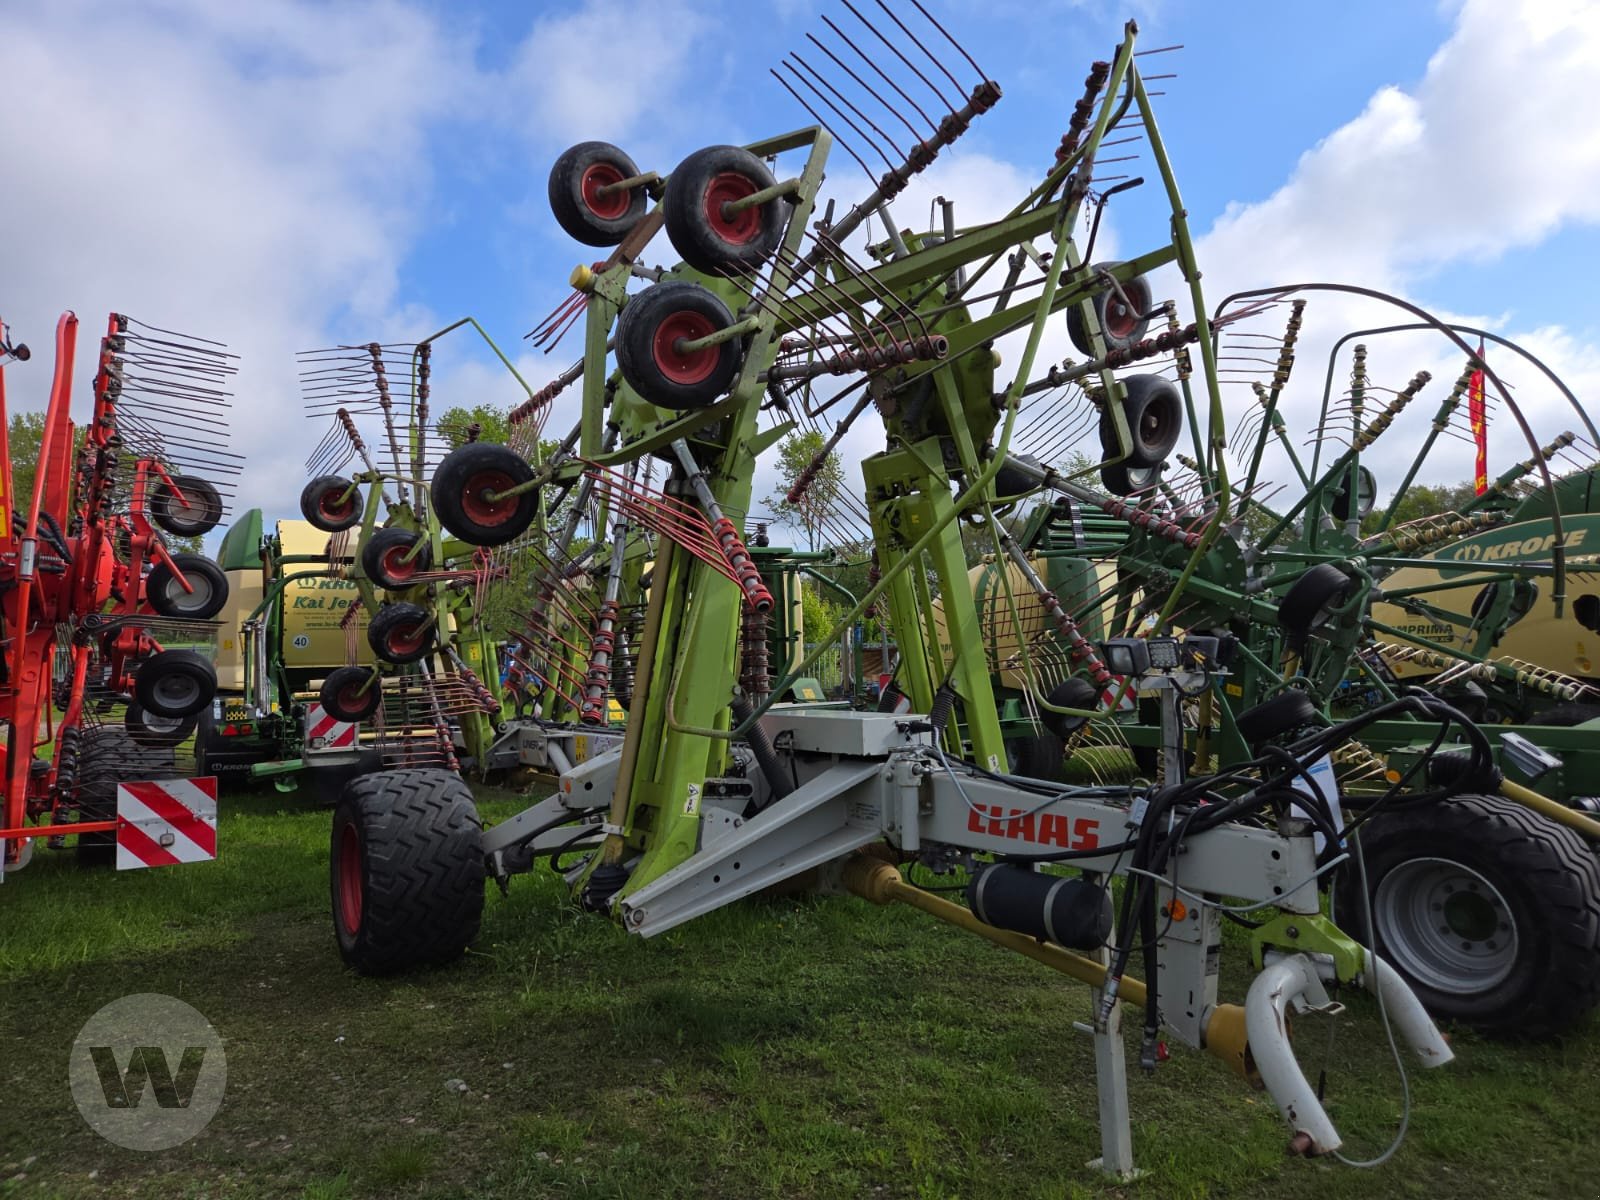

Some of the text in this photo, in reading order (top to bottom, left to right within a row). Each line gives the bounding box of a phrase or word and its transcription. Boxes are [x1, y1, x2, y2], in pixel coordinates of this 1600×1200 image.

[293, 596, 325, 608] Kai
[294, 637, 307, 647] 40
[967, 803, 1100, 852] CLAAS
